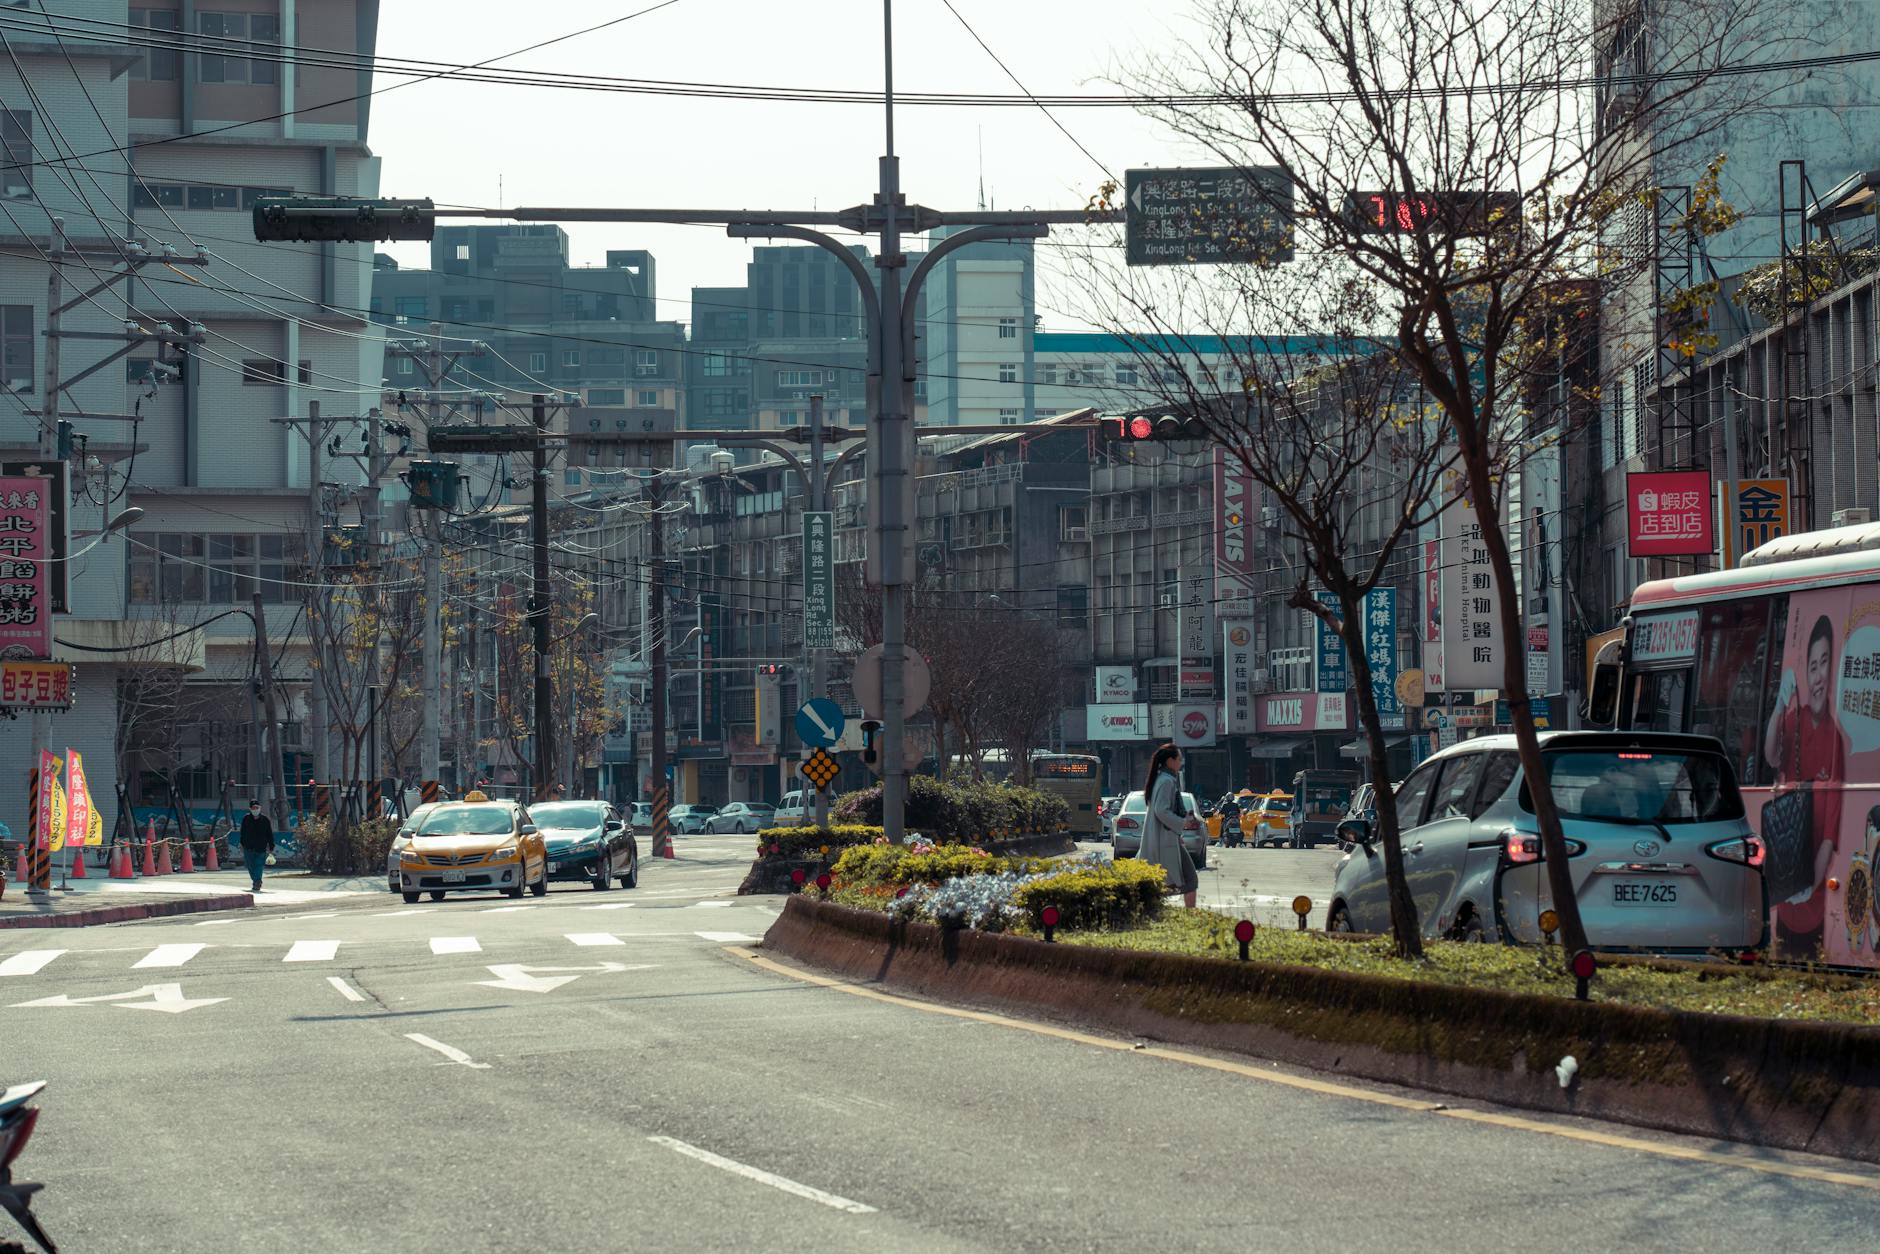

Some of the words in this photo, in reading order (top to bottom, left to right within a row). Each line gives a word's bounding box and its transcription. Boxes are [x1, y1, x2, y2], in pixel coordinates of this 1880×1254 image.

[1661, 491, 1701, 511] 蝦皮
[1639, 511, 1702, 534] 店到店
[811, 524, 825, 596] 興隆路二段
[1461, 557, 1469, 594] Animal
[806, 596, 824, 605] Xing
[806, 604, 826, 613] Long
[826, 618, 832, 627] 2
[1461, 598, 1470, 642] Hospital
[1323, 621, 1341, 669] 程車
[2, 670, 68, 703] 包子豆漿
[1438, 694, 1463, 704] YP
[1266, 698, 1303, 726] MAXXIS
[1184, 719, 1207, 734] SYM
